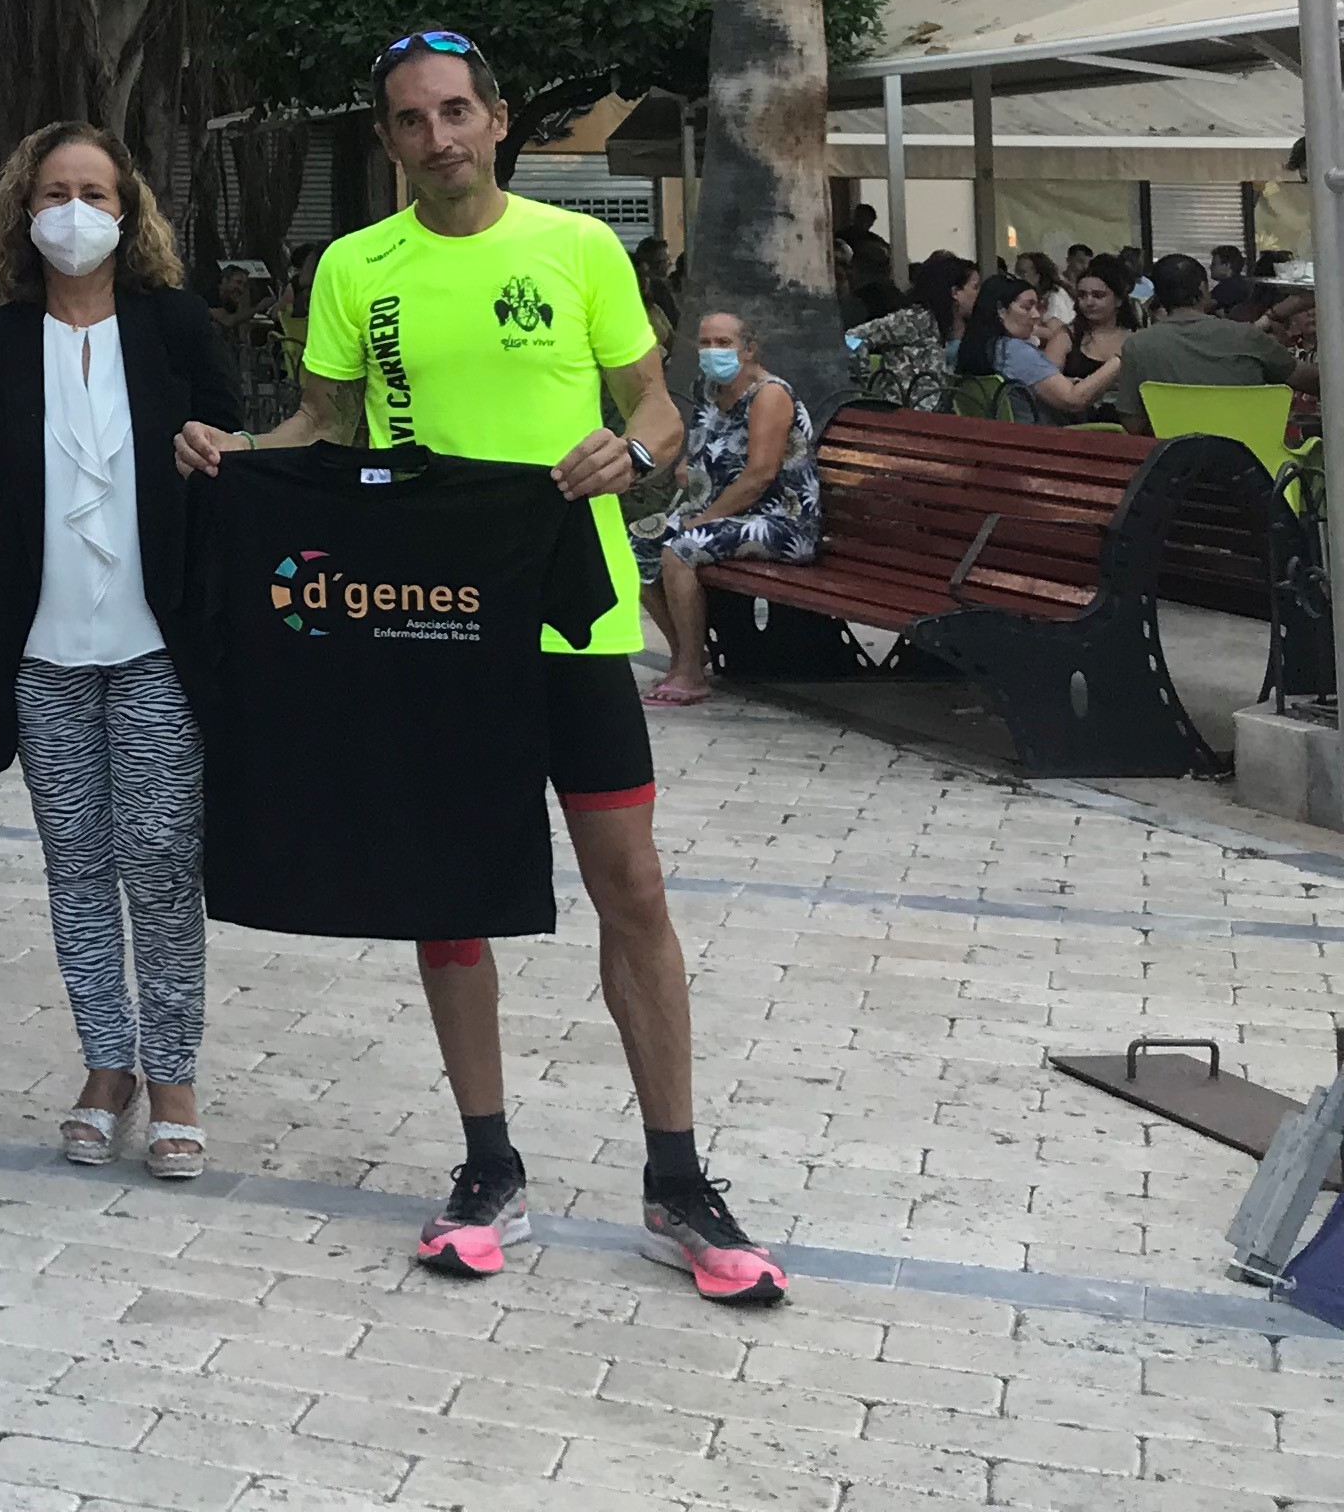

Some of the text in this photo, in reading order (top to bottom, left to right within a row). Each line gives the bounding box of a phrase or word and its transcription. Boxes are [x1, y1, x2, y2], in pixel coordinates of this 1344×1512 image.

[369, 295, 411, 408] CARNERO
[406, 619, 480, 631] Asociación de
[374, 628, 480, 641] Enfermedades Raras
